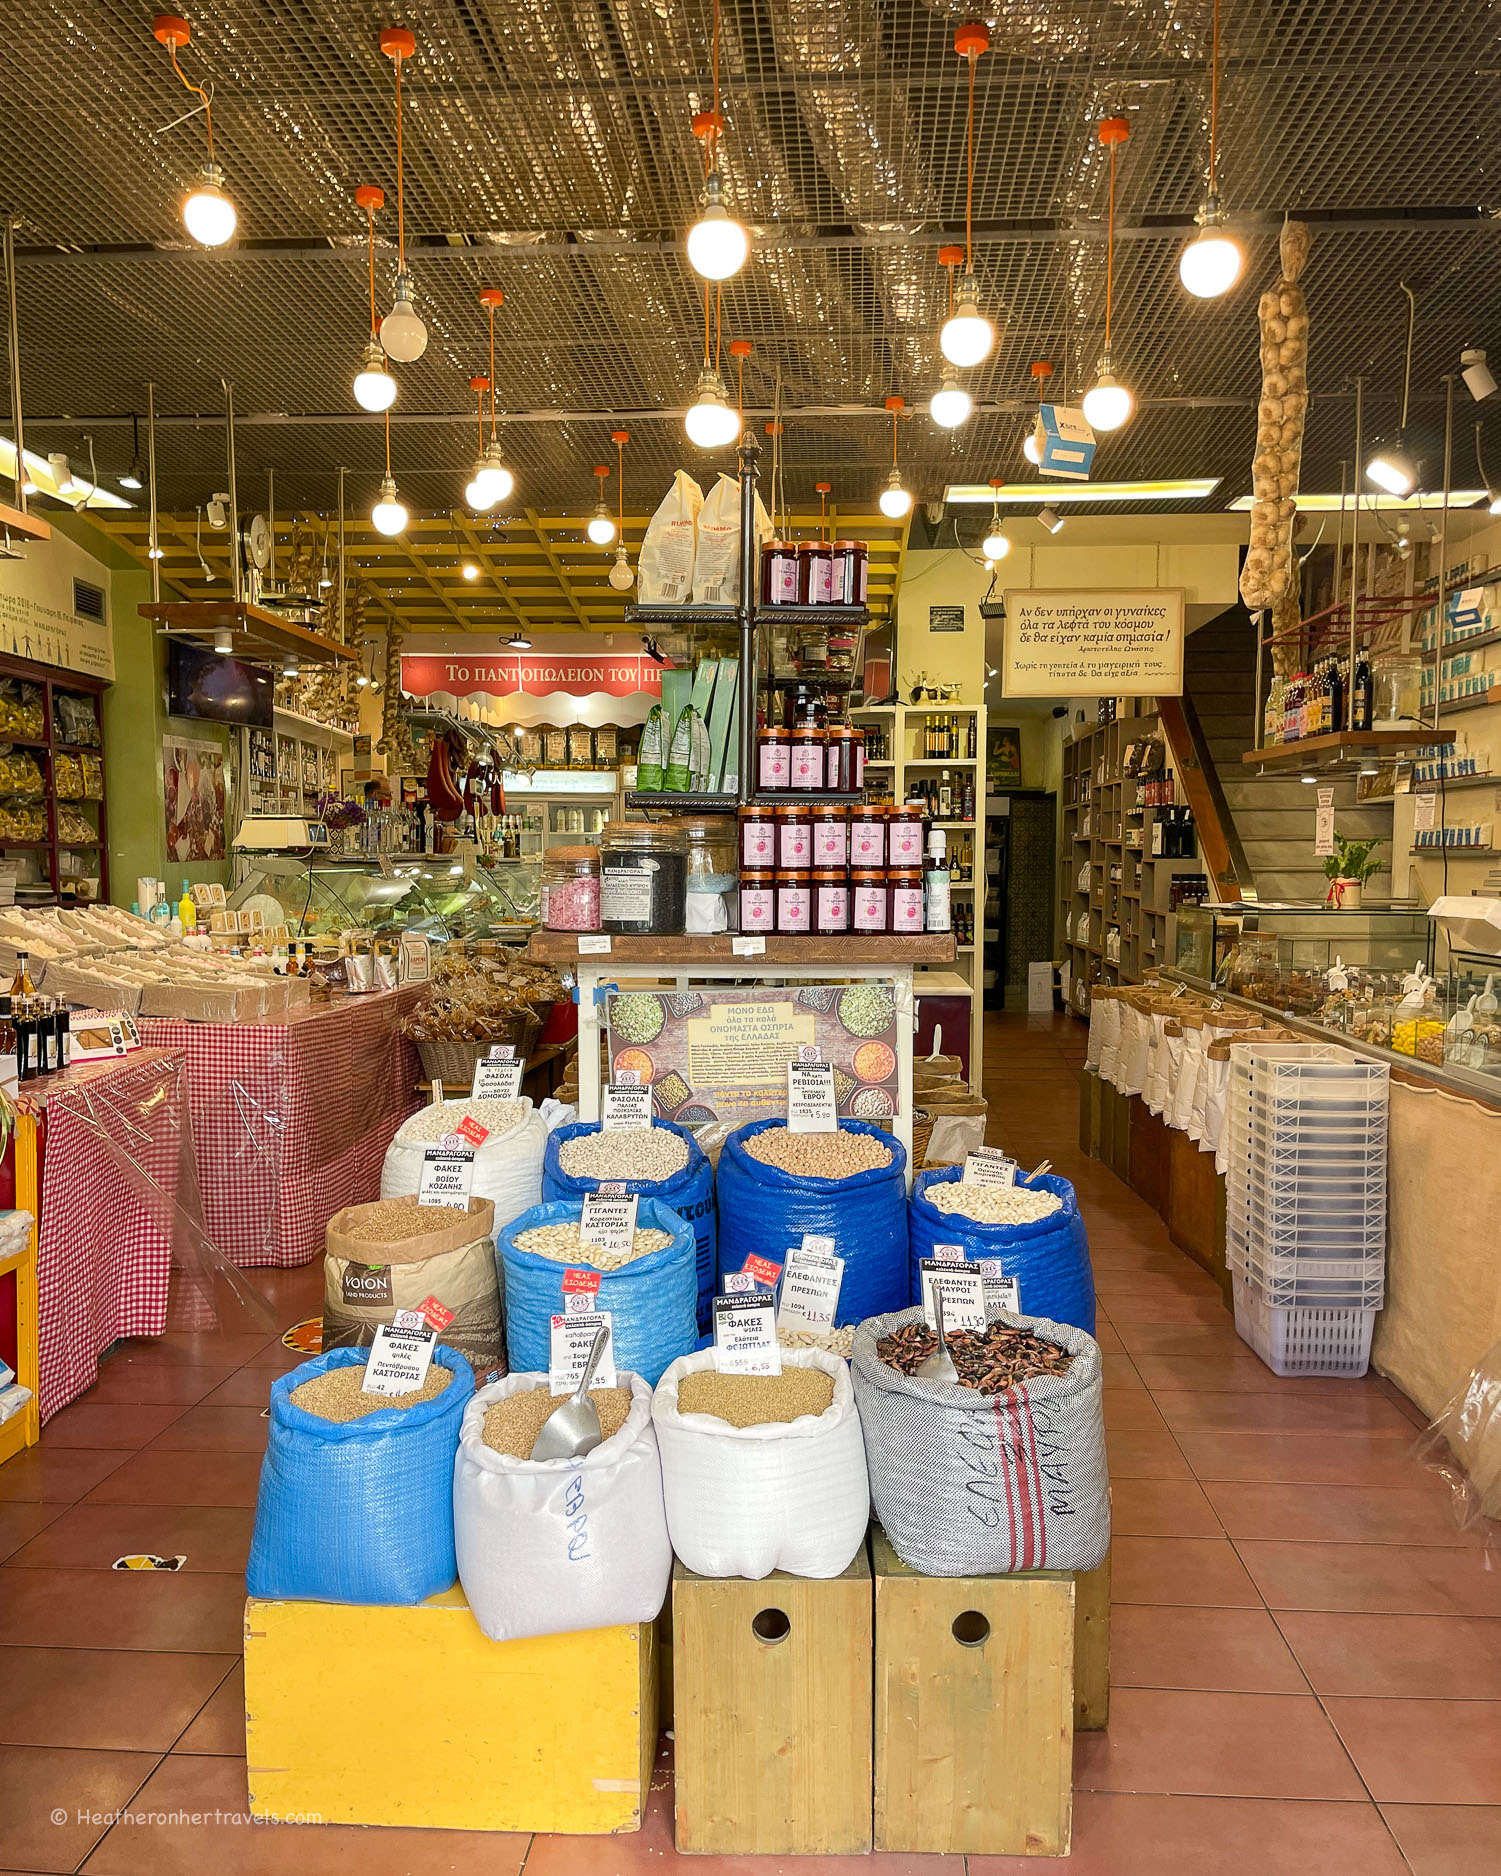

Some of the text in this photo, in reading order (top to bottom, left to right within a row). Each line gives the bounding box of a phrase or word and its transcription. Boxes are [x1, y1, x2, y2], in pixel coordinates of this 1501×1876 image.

[1020, 605, 1166, 619] Αν δεν υπήρχαν οι γυναίκες
[1020, 619, 1154, 632] όλα τα λεφτά του κόσμου
[1020, 632, 1031, 642] δε
[1034, 632, 1048, 642] θα
[1050, 632, 1081, 645] είχαν
[1083, 632, 1114, 645] καμία
[1014, 661, 1037, 671] Χωρίς
[1049, 661, 1078, 671] γοητεία
[445, 664, 470, 682] Το
[474, 668, 605, 682] ΠΑΝΤΟΠΩΛΕΙΟΝ
[608, 668, 639, 682] ΤΟΥ
[1049, 670, 1076, 678] τίποτα
[1078, 669, 1088, 677] δε
[728, 1006, 775, 1015] ΜΟΝΟ ΕΔΩ
[756, 1015, 777, 1023] καλά
[710, 1023, 794, 1033] ΟΝΟΜΑΣΤΑ ΟΣΠΡΙΑ
[725, 1032, 780, 1042] της ΕΛΛΑΔΑΣ
[426, 1150, 474, 1158] ΜΑΝΔΡΑΓΟΡΑΣ
[434, 1164, 463, 1173] ΦΑΚΕΣ
[972, 1161, 1009, 1172] ΓΙΓΑΝΤΕΣ
[924, 1260, 979, 1270] ΜΑΝΔΡΑΓΟΡΑΣ
[345, 1275, 388, 1290] VOION
[786, 1270, 838, 1287] ΕΛΕΦΑΝΤΕΣ
[928, 1277, 977, 1287] ΕΛΕΦΑΝΤΕΣ
[791, 1285, 829, 1298] ΠΡΕΣΠΩΝ
[716, 1294, 773, 1306] ΜΑΝΔΡΑΓΟΡΑΣ
[941, 1297, 975, 1305] ΡΕΣΠΩΝ
[728, 1317, 763, 1328] ΦΑΚΕΣ
[384, 1327, 432, 1338] ΜΑΝΔΡΑΓΟΡΑΣ
[389, 1342, 420, 1352] ΦΑΚΕΣ
[569, 1340, 594, 1349] ΦΑΚΕ
[391, 1352, 412, 1361] ψιλές
[572, 1361, 589, 1369] ΕΒΡ
[372, 1368, 420, 1381] ΚΑΣΤΟΡΙΑΣ
